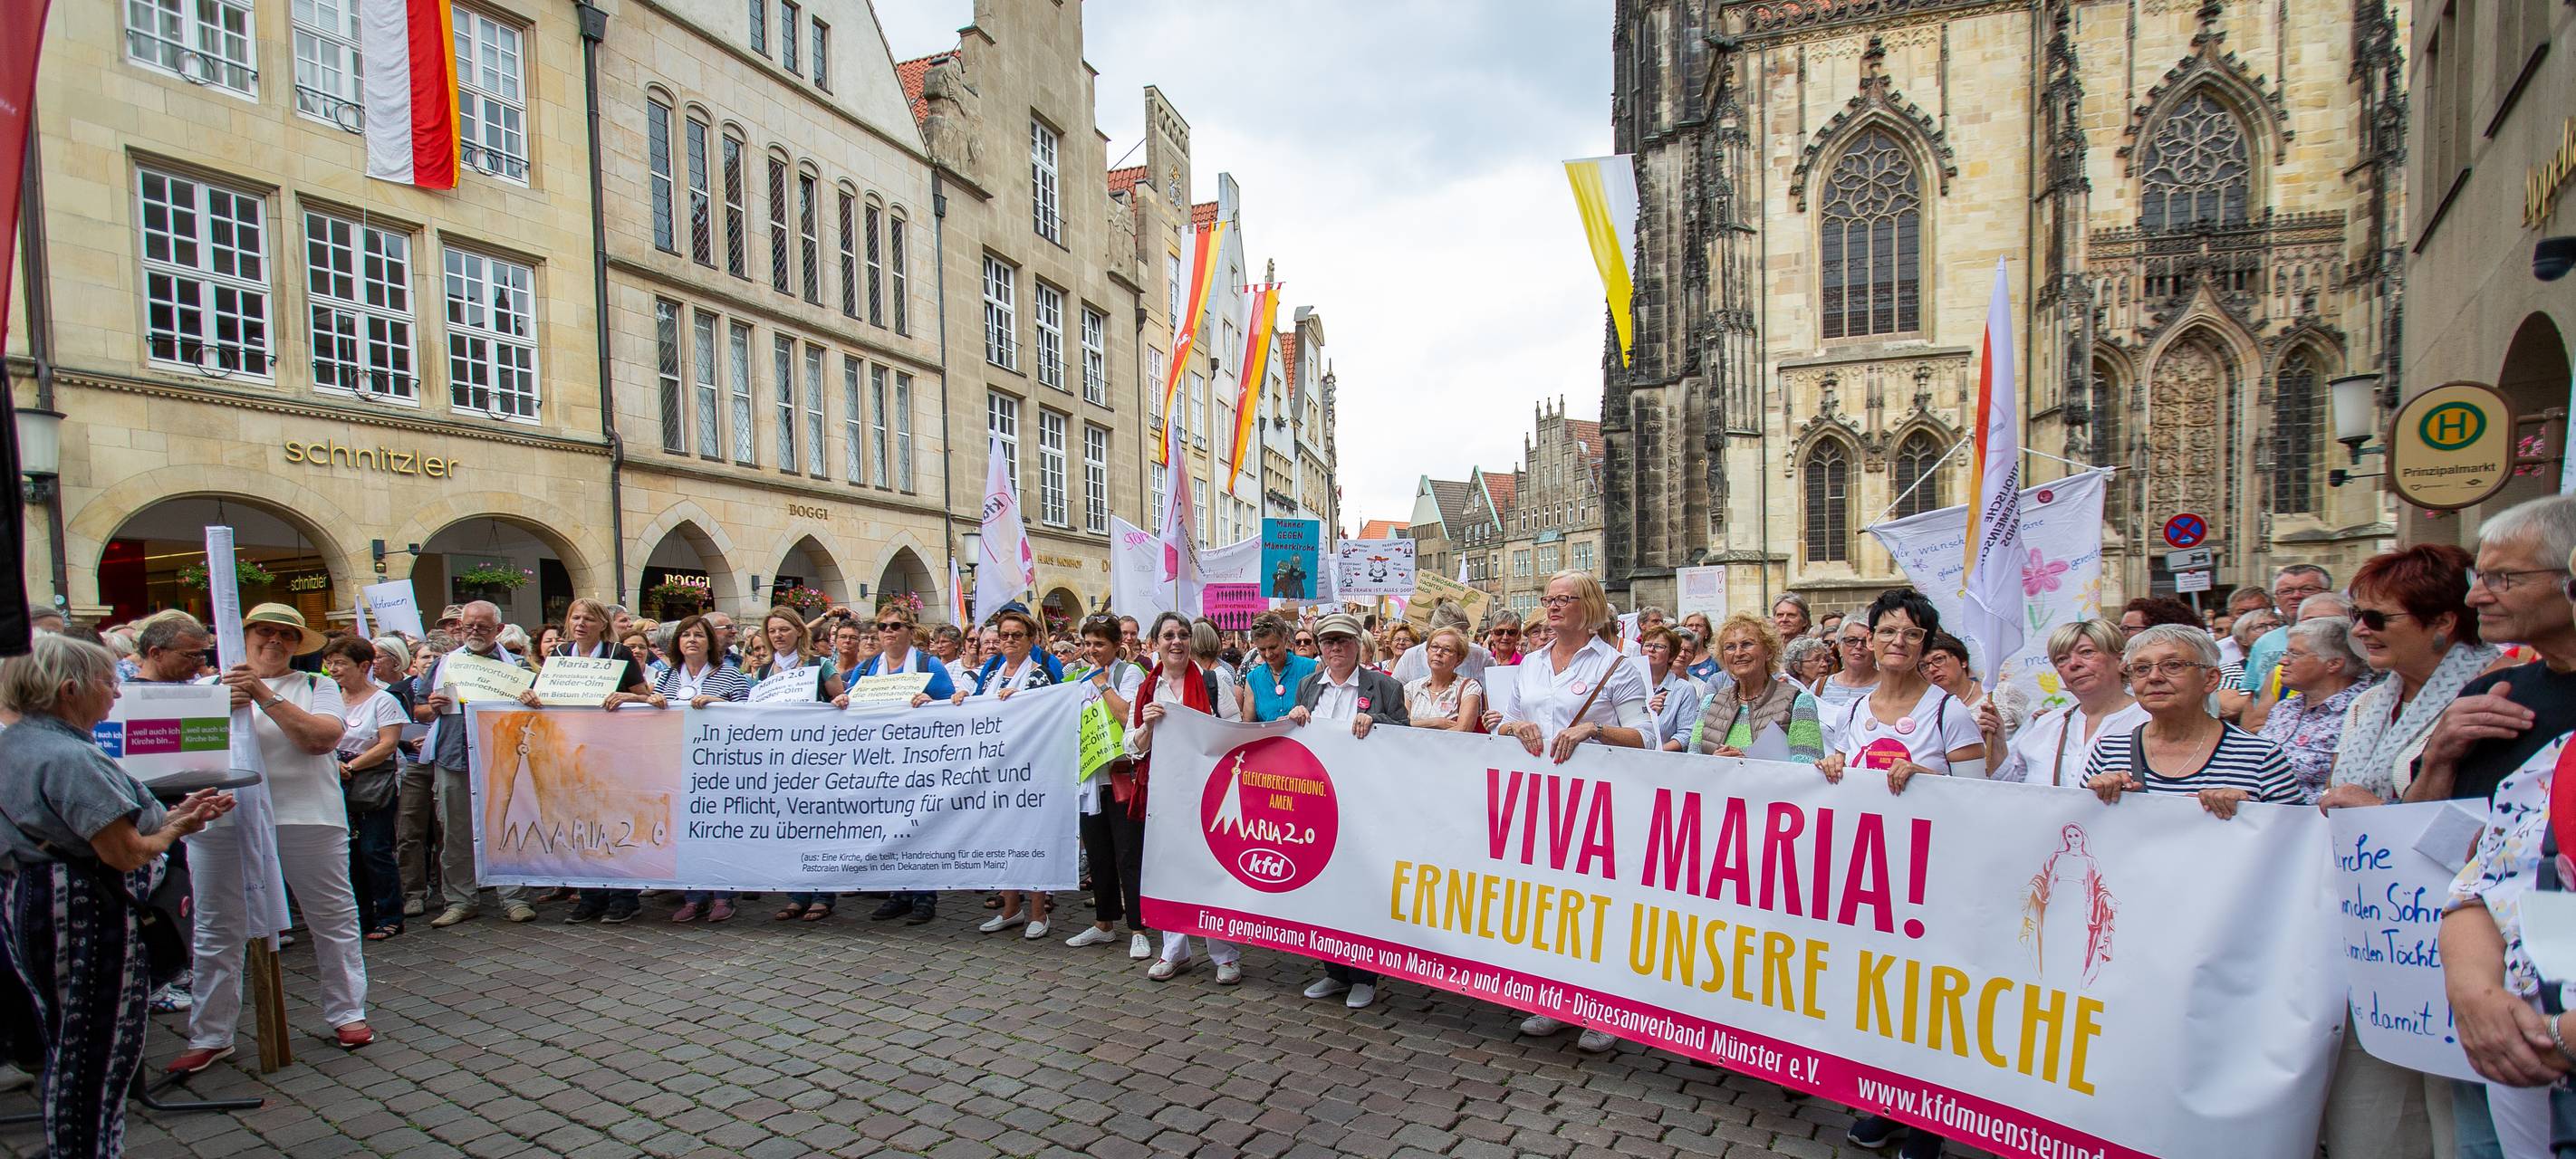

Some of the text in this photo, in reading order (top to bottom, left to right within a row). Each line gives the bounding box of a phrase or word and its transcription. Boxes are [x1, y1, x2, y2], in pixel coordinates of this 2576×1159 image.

[2438, 412, 2466, 440] H
[285, 436, 458, 477] schnitzler
[2403, 463, 2495, 478] Prinzipalmarkt
[788, 503, 828, 520] BOGGI
[1277, 532, 1303, 540] GEGEN
[1918, 534, 1965, 555] wünsch
[291, 574, 327, 590] schnitzler
[665, 573, 711, 589] BOGGI
[371, 596, 407, 608] Vertrauen
[556, 660, 611, 670] Maria 2.0
[788, 670, 804, 678] 2.0
[1084, 708, 1099, 724] 2.0
[131, 737, 155, 745] Kirche
[168, 727, 180, 735] ich
[725, 724, 783, 745] jedem
[791, 724, 825, 742] und
[829, 724, 876, 745] jeder
[882, 721, 964, 741] Getauften
[970, 716, 1003, 735] lebt
[692, 741, 1004, 765] Christus in dieser Welt. Insofern hat
[689, 761, 1031, 793] jede und jeder Getaufte das Recht und
[1243, 771, 1326, 797] GLEICHBERECHTIGUNG.
[690, 789, 1045, 818] die Pflicht, Verantwortung für und in der
[1269, 793, 1294, 811] AMEN.
[688, 820, 744, 838] Kirche
[750, 825, 769, 839] zu
[776, 820, 887, 842] übernehmen,
[822, 853, 838, 861] Eine
[839, 853, 862, 863] Kirche,
[865, 853, 877, 861] die
[901, 850, 956, 860] Handreichung
[958, 849, 970, 858] für
[972, 849, 984, 858] die
[985, 850, 1005, 858] erste
[1008, 849, 1030, 858] Phase
[1032, 849, 1045, 857] des
[1486, 769, 1932, 939] VIVA MARIA!
[802, 860, 1008, 874] Pastoralen Weges in den Dekanaten im Bistum Mainz)
[1249, 854, 1284, 876] kfd
[2387, 882, 2444, 924] Söhn
[2381, 928, 2441, 969] Töcht
[1390, 860, 2104, 1097] ERNEUERT UNSERE KIRCHE
[1198, 910, 1224, 932] Eine
[1228, 918, 1305, 947] gemeinsame
[1310, 930, 1374, 963] Kampagne
[1379, 949, 1401, 970] von
[1405, 952, 1445, 980] Maria
[1448, 967, 1469, 986] 2.0
[1474, 972, 1500, 993] und
[1504, 976, 1534, 1002] dem
[1710, 1029, 1783, 1073] Münster
[1789, 1056, 1821, 1086] e.V.
[2370, 991, 2436, 1036] damit
